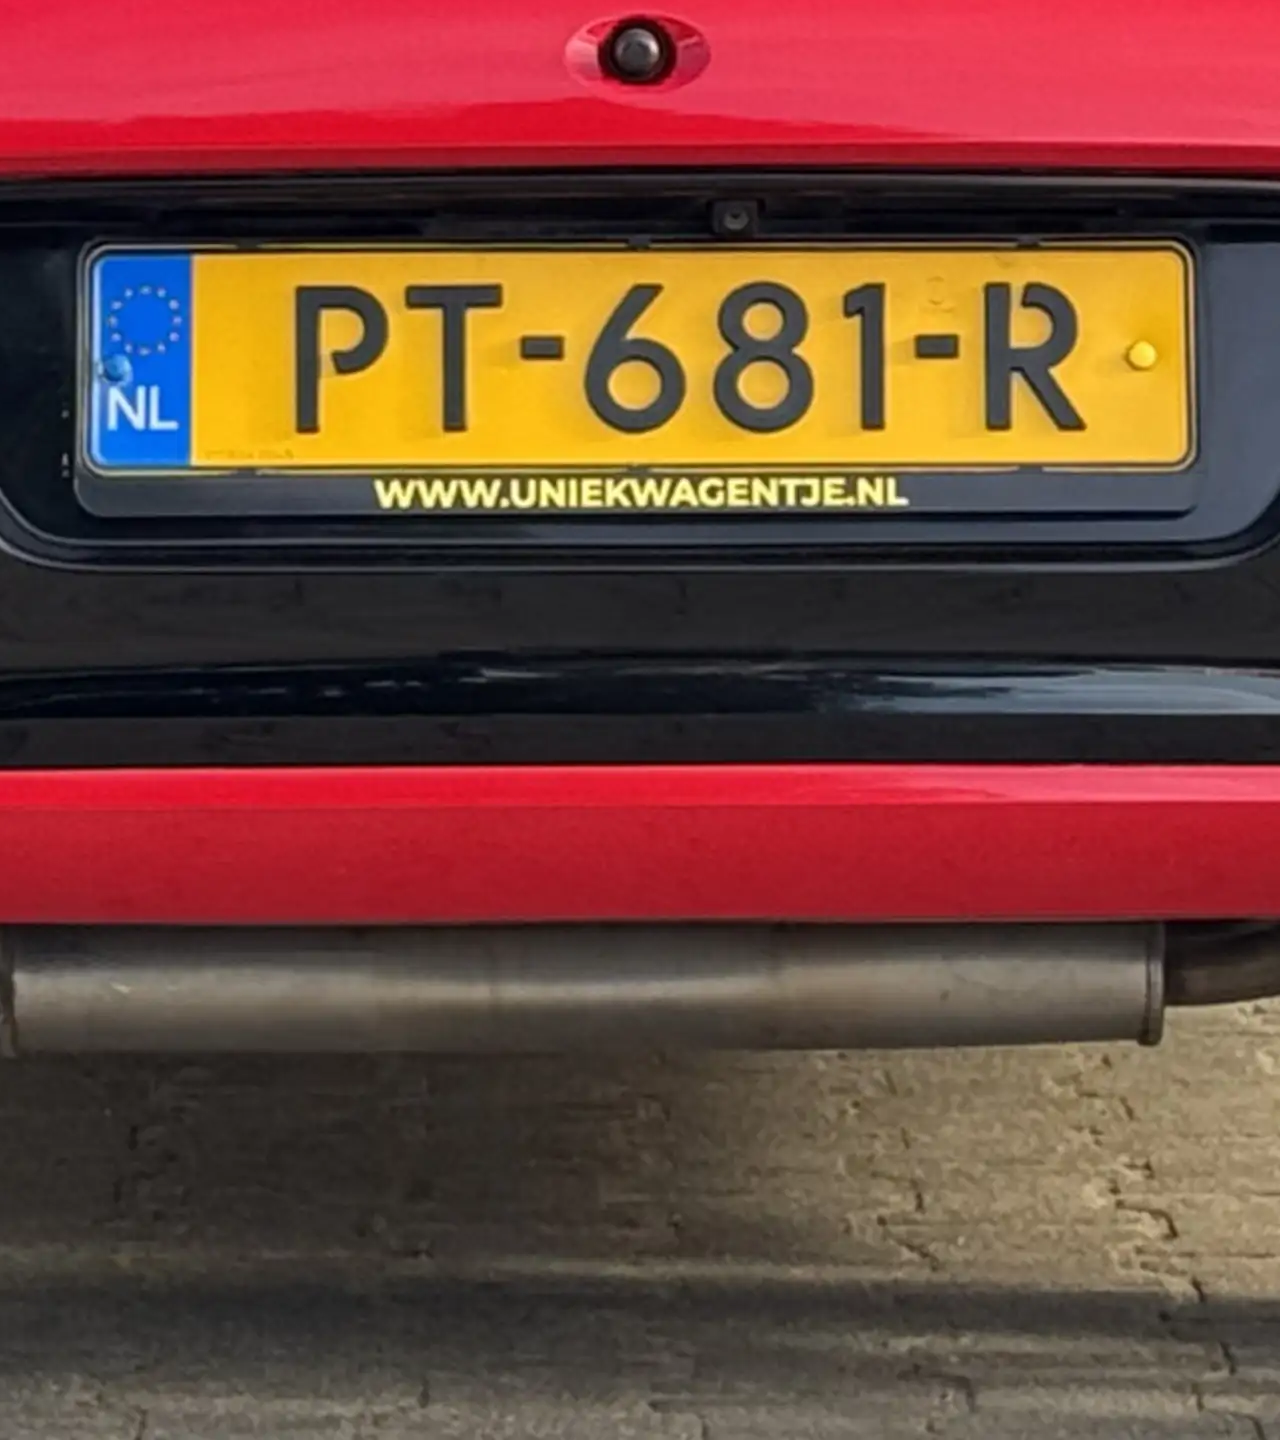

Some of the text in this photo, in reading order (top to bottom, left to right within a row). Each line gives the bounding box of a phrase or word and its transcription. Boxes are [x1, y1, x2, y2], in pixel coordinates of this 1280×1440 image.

[293, 280, 1087, 434] PT-681-R
[107, 384, 180, 431] NL
[373, 476, 910, 510] WWW.UNIEKWAGENTJE.NL
